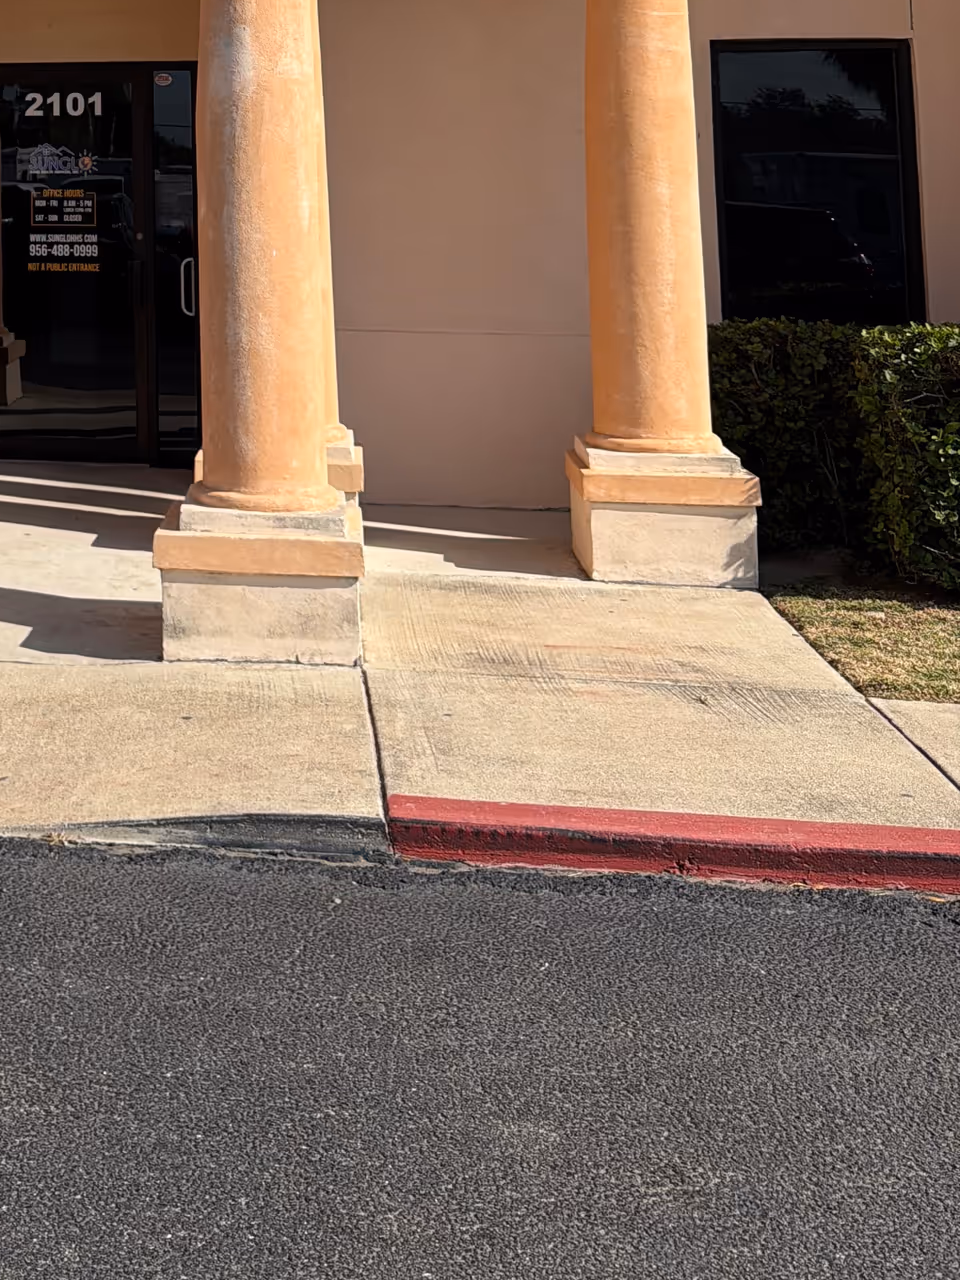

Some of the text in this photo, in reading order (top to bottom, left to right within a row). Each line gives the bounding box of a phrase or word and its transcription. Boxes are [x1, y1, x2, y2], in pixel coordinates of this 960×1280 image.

[24, 92, 102, 117] 2101
[42, 189, 85, 198] OFFICE HOURS
[63, 214, 83, 222] CLOSED
[29, 244, 99, 257] 956-488-0999
[27, 262, 101, 273] NOT A PUBLIC ENTRANCE
